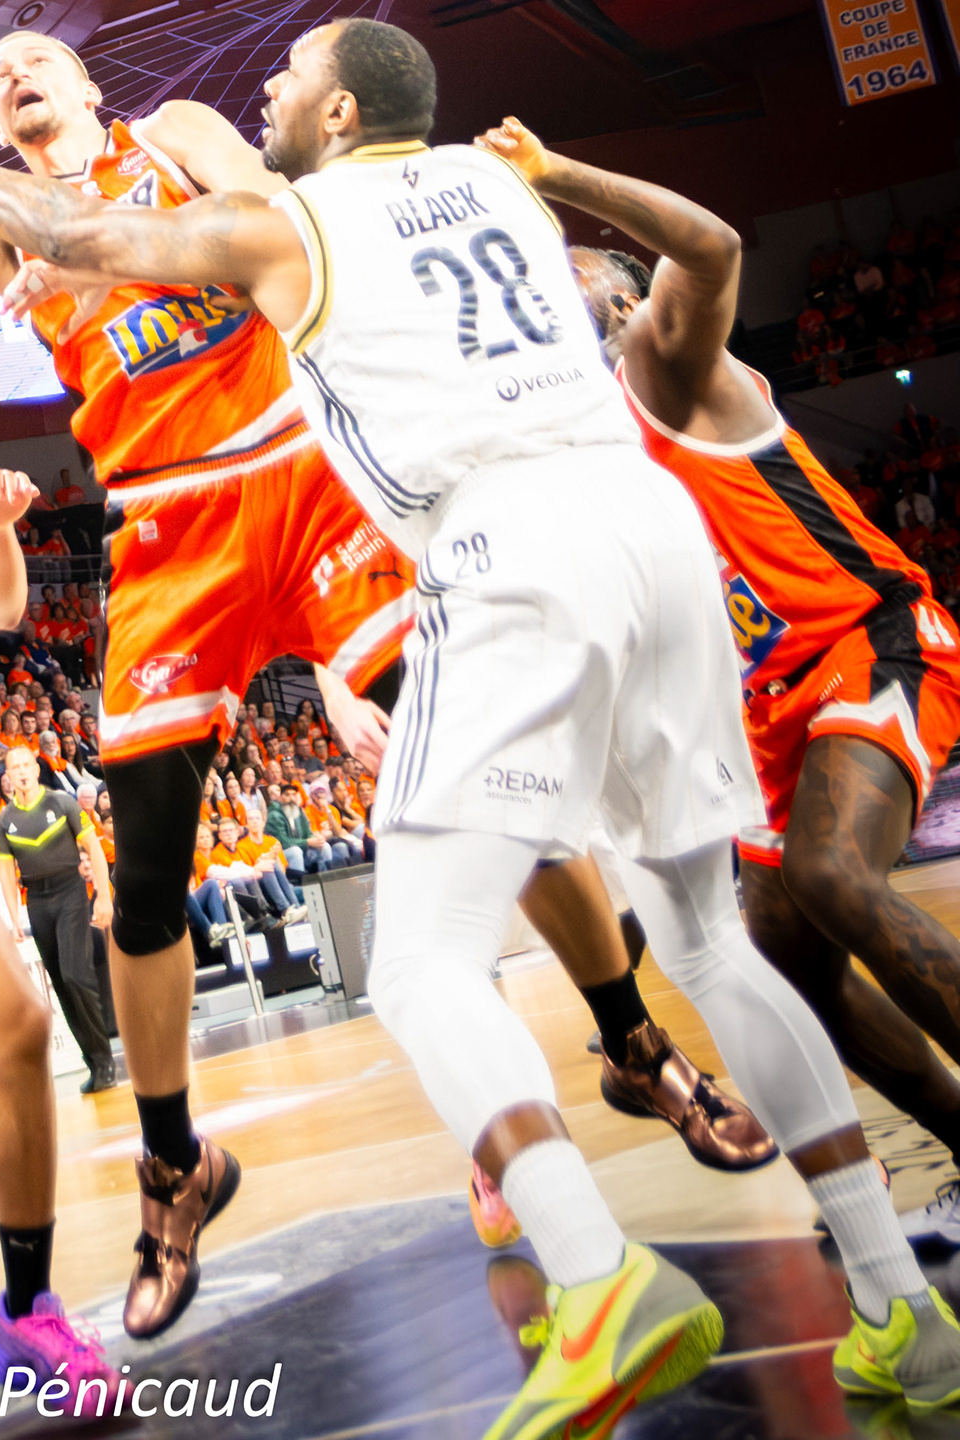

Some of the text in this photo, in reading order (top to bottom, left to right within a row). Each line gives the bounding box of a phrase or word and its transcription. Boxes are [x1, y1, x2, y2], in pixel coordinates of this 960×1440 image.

[842, 31, 921, 63] FRANCE
[862, 20, 890, 39] DE
[846, 59, 929, 98] 1964
[384, 181, 491, 240] BLACK
[410, 227, 565, 361] 28
[522, 366, 586, 393] VEOLIA
[452, 531, 493, 581] 28
